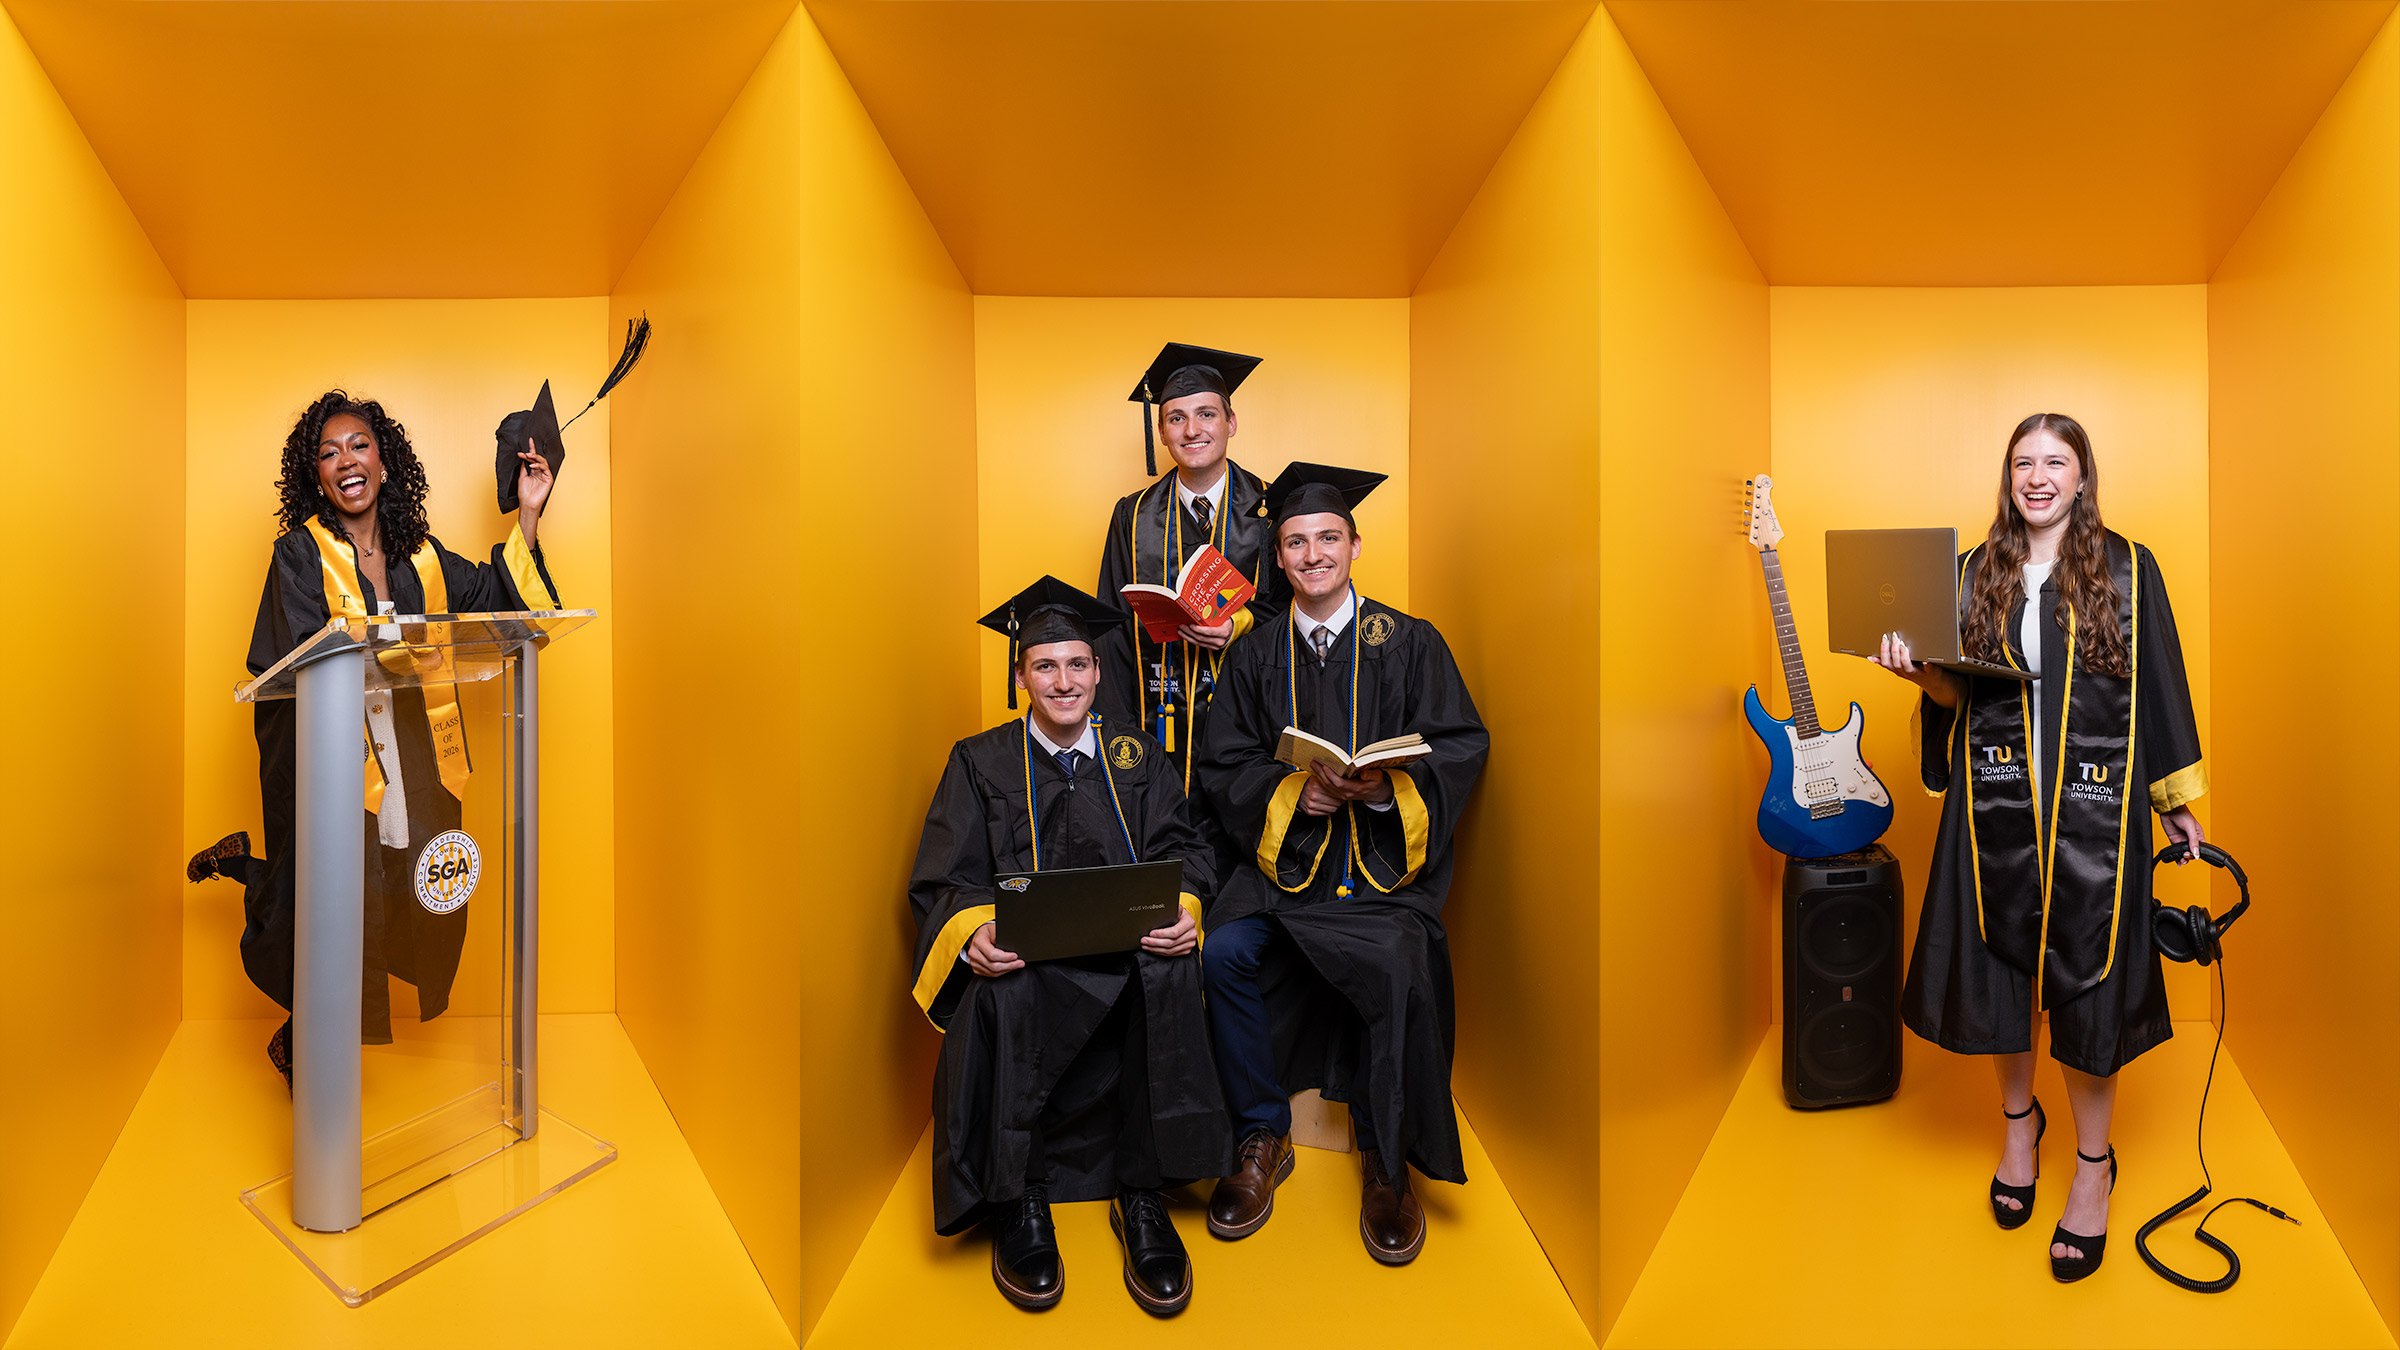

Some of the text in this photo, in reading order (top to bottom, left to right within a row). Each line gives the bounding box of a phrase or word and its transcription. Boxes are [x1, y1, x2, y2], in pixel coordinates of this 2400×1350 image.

[1189, 556, 1222, 603] CROSSING
[1193, 588, 1206, 607] THE
[1198, 579, 1222, 612] CHASM
[433, 716, 459, 732] CLASS
[442, 733, 453, 743] OF
[443, 744, 459, 758] 2026
[1982, 745, 2012, 764] TU
[1980, 765, 2020, 775] TOWSON
[2079, 762, 2108, 783] TU
[2071, 783, 2113, 795] TOWSON
[425, 834, 473, 858] LEADERSHIP
[435, 846, 462, 860] TOWSON
[427, 858, 469, 884] SGA
[463, 858, 478, 897] SERVICE
[418, 871, 454, 910] COMMITMENT
[432, 880, 465, 897] UNIVERSITY
